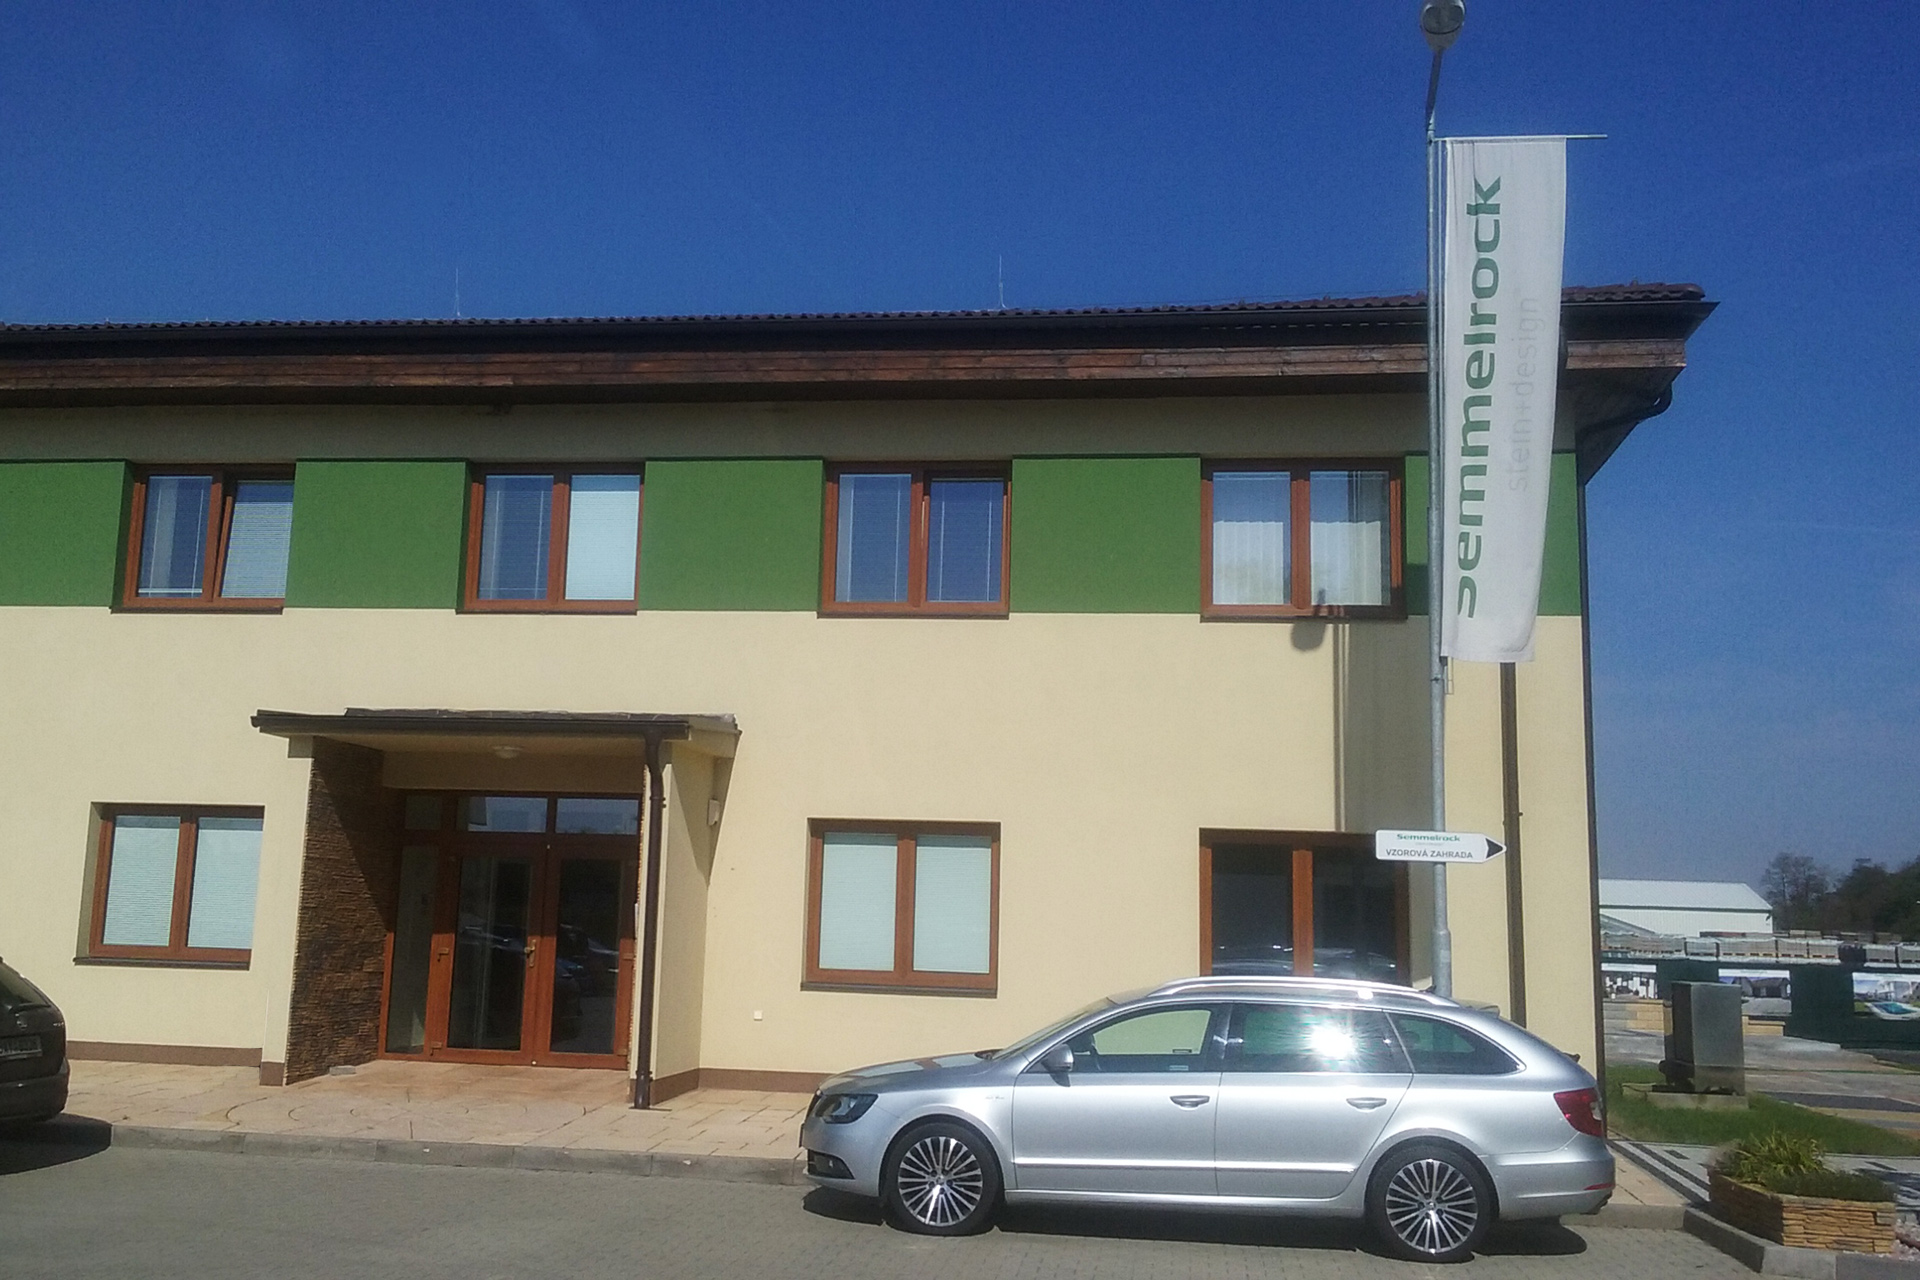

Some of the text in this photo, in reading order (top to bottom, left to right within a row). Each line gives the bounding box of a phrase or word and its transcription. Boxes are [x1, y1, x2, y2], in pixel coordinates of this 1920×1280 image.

[1397, 833, 1460, 842] Semmelrock
[1386, 848, 1473, 859] VZOROVÁ ZAHRADA
